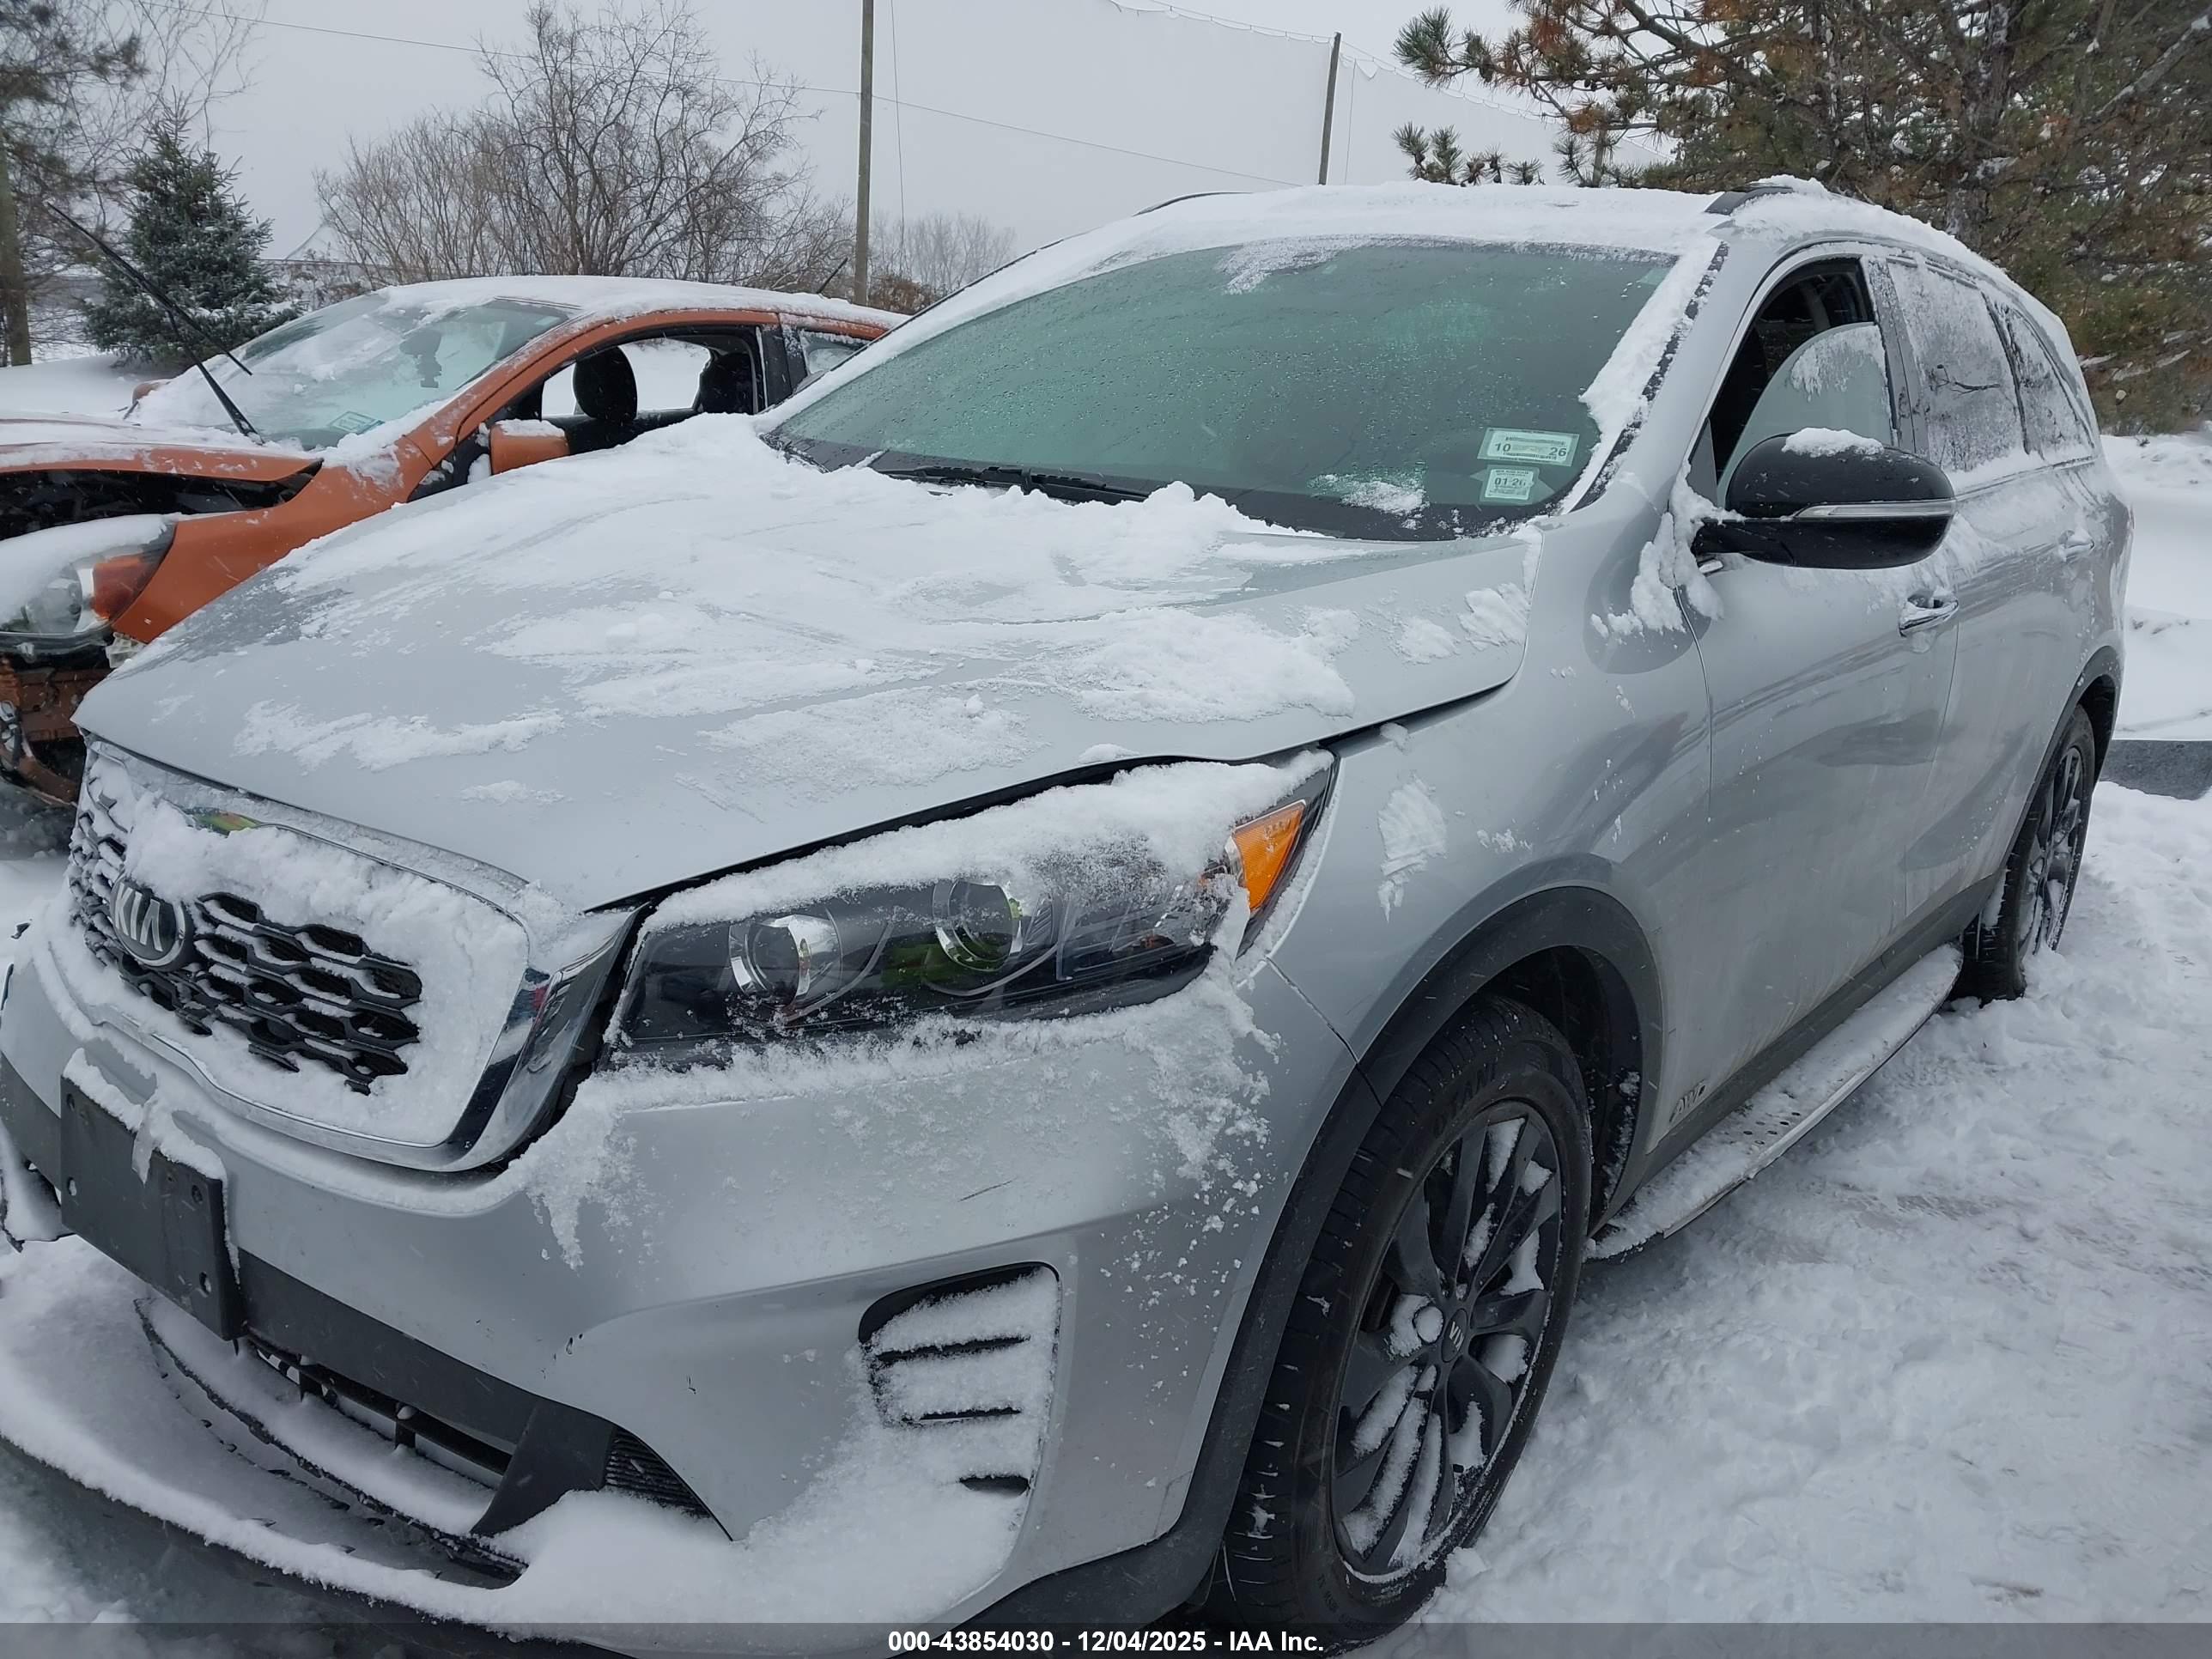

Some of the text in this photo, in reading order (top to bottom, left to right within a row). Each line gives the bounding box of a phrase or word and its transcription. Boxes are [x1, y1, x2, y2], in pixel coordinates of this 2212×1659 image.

[1494, 443, 1511, 453] 10
[1549, 447, 1568, 457] 26
[114, 881, 163, 952] KIA
[1449, 1321, 1465, 1352] KIA
